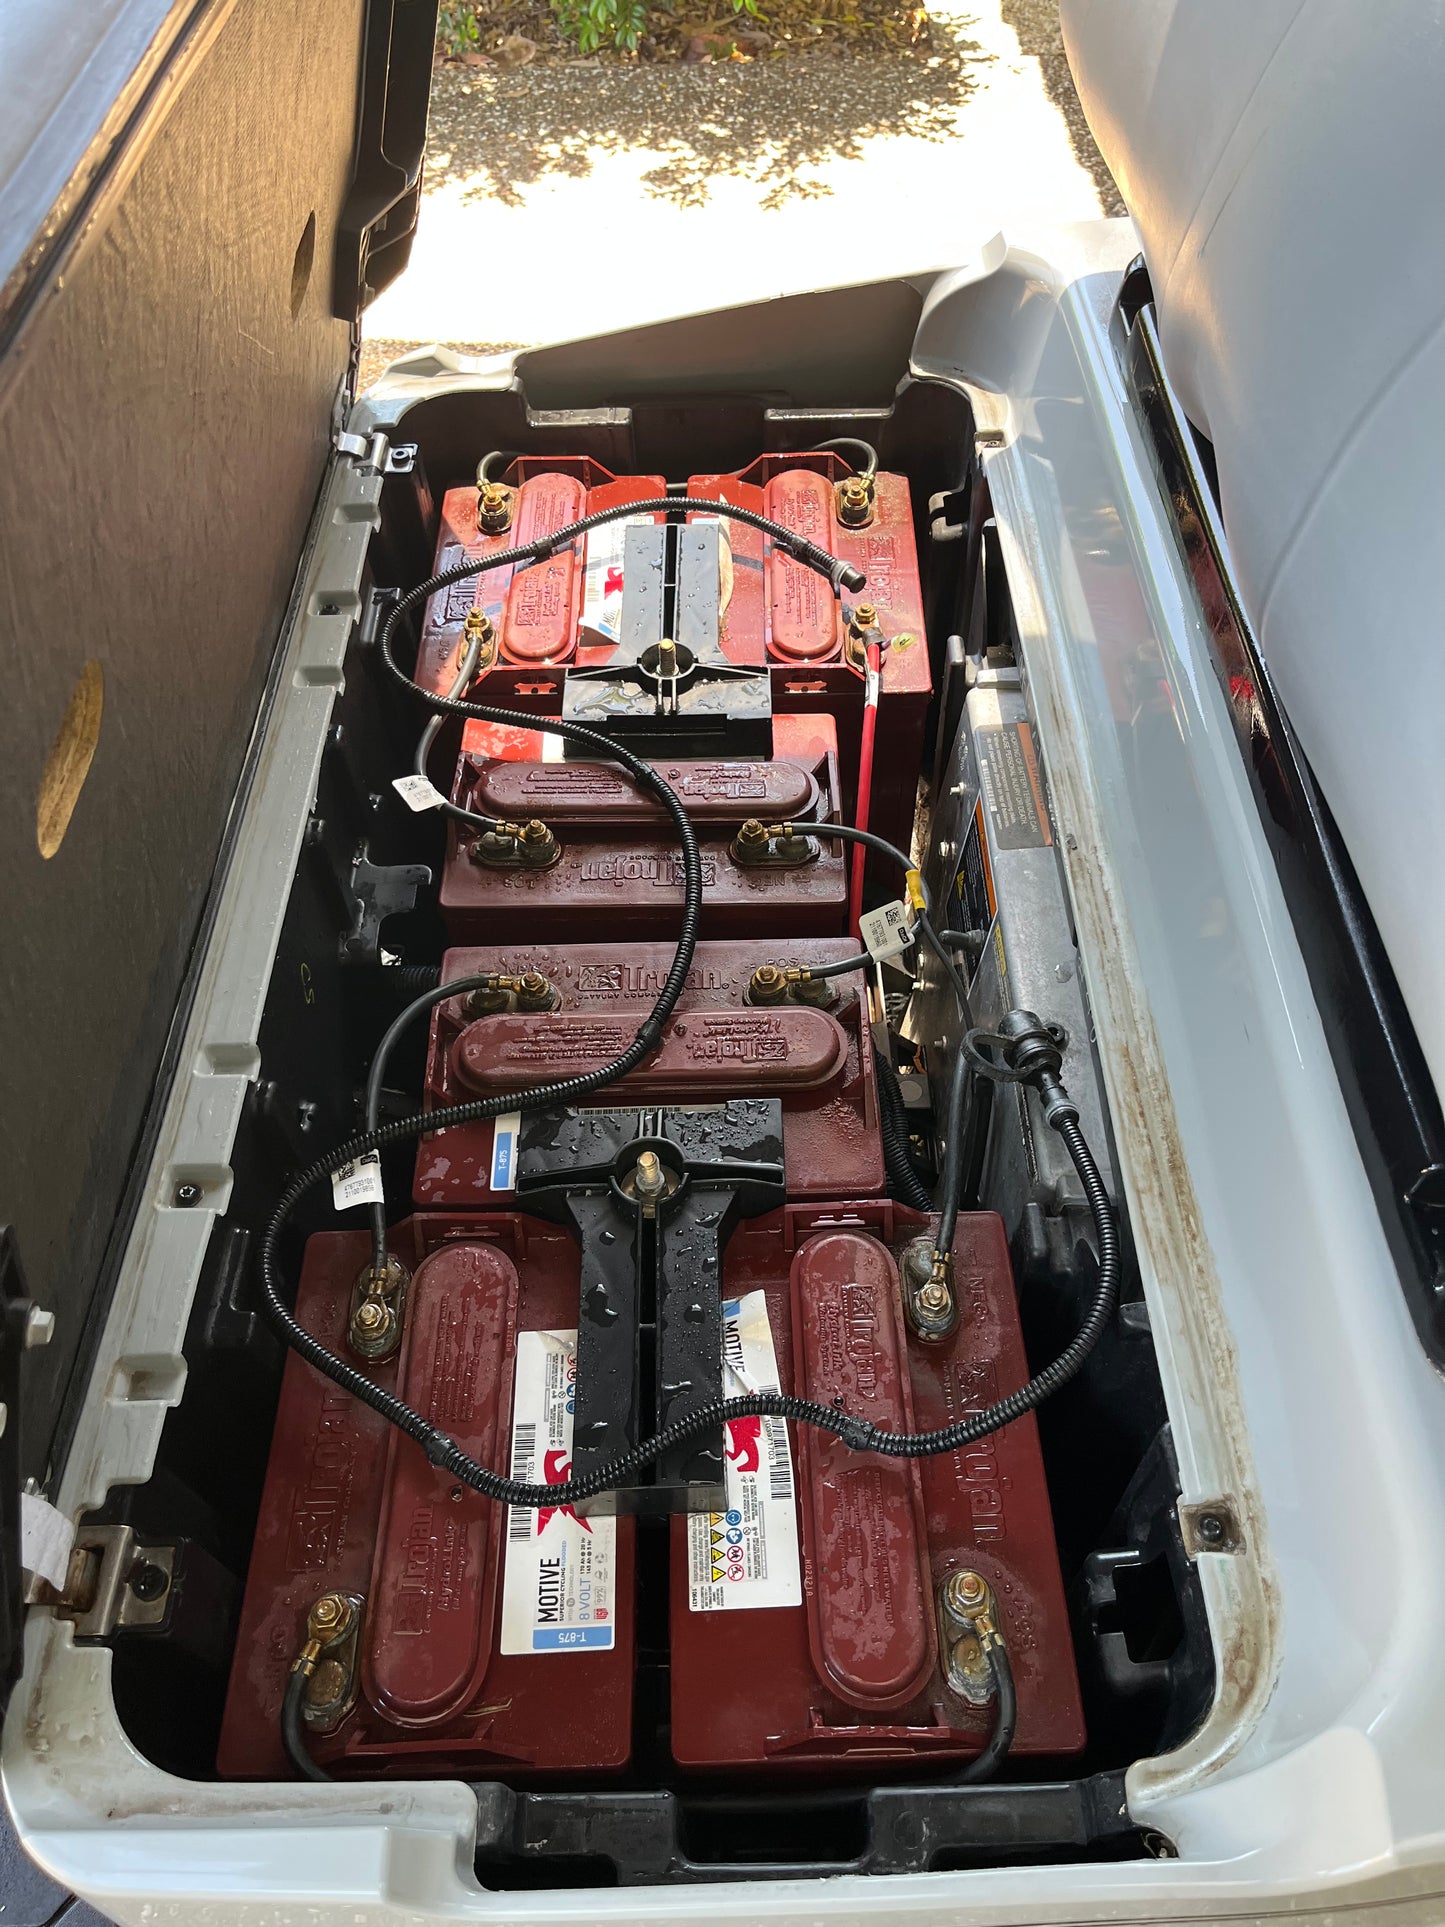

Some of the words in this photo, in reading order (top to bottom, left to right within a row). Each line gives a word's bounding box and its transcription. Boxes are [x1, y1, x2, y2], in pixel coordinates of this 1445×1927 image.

[863, 557, 900, 611] Trojan
[1000, 731, 1010, 749] CAUSE
[1004, 748, 1016, 777] PERSONAL
[1017, 765, 1028, 788] BATTERY
[1010, 777, 1020, 796] INJURY
[1022, 789, 1035, 820] TERMINALS
[1029, 820, 1038, 833] CAN
[580, 855, 668, 887] Trojan
[624, 963, 722, 992] Troan
[498, 1150, 508, 1170] T-875
[850, 1315, 882, 1390] Trojan
[764, 1418, 774, 1460] 103971703
[395, 1503, 440, 1594] Trojan
[536, 1556, 560, 1623] MOTIVE
[578, 1577, 591, 1610] VOLT
[579, 1612, 590, 1620] 8
[558, 1632, 588, 1644] T-875
